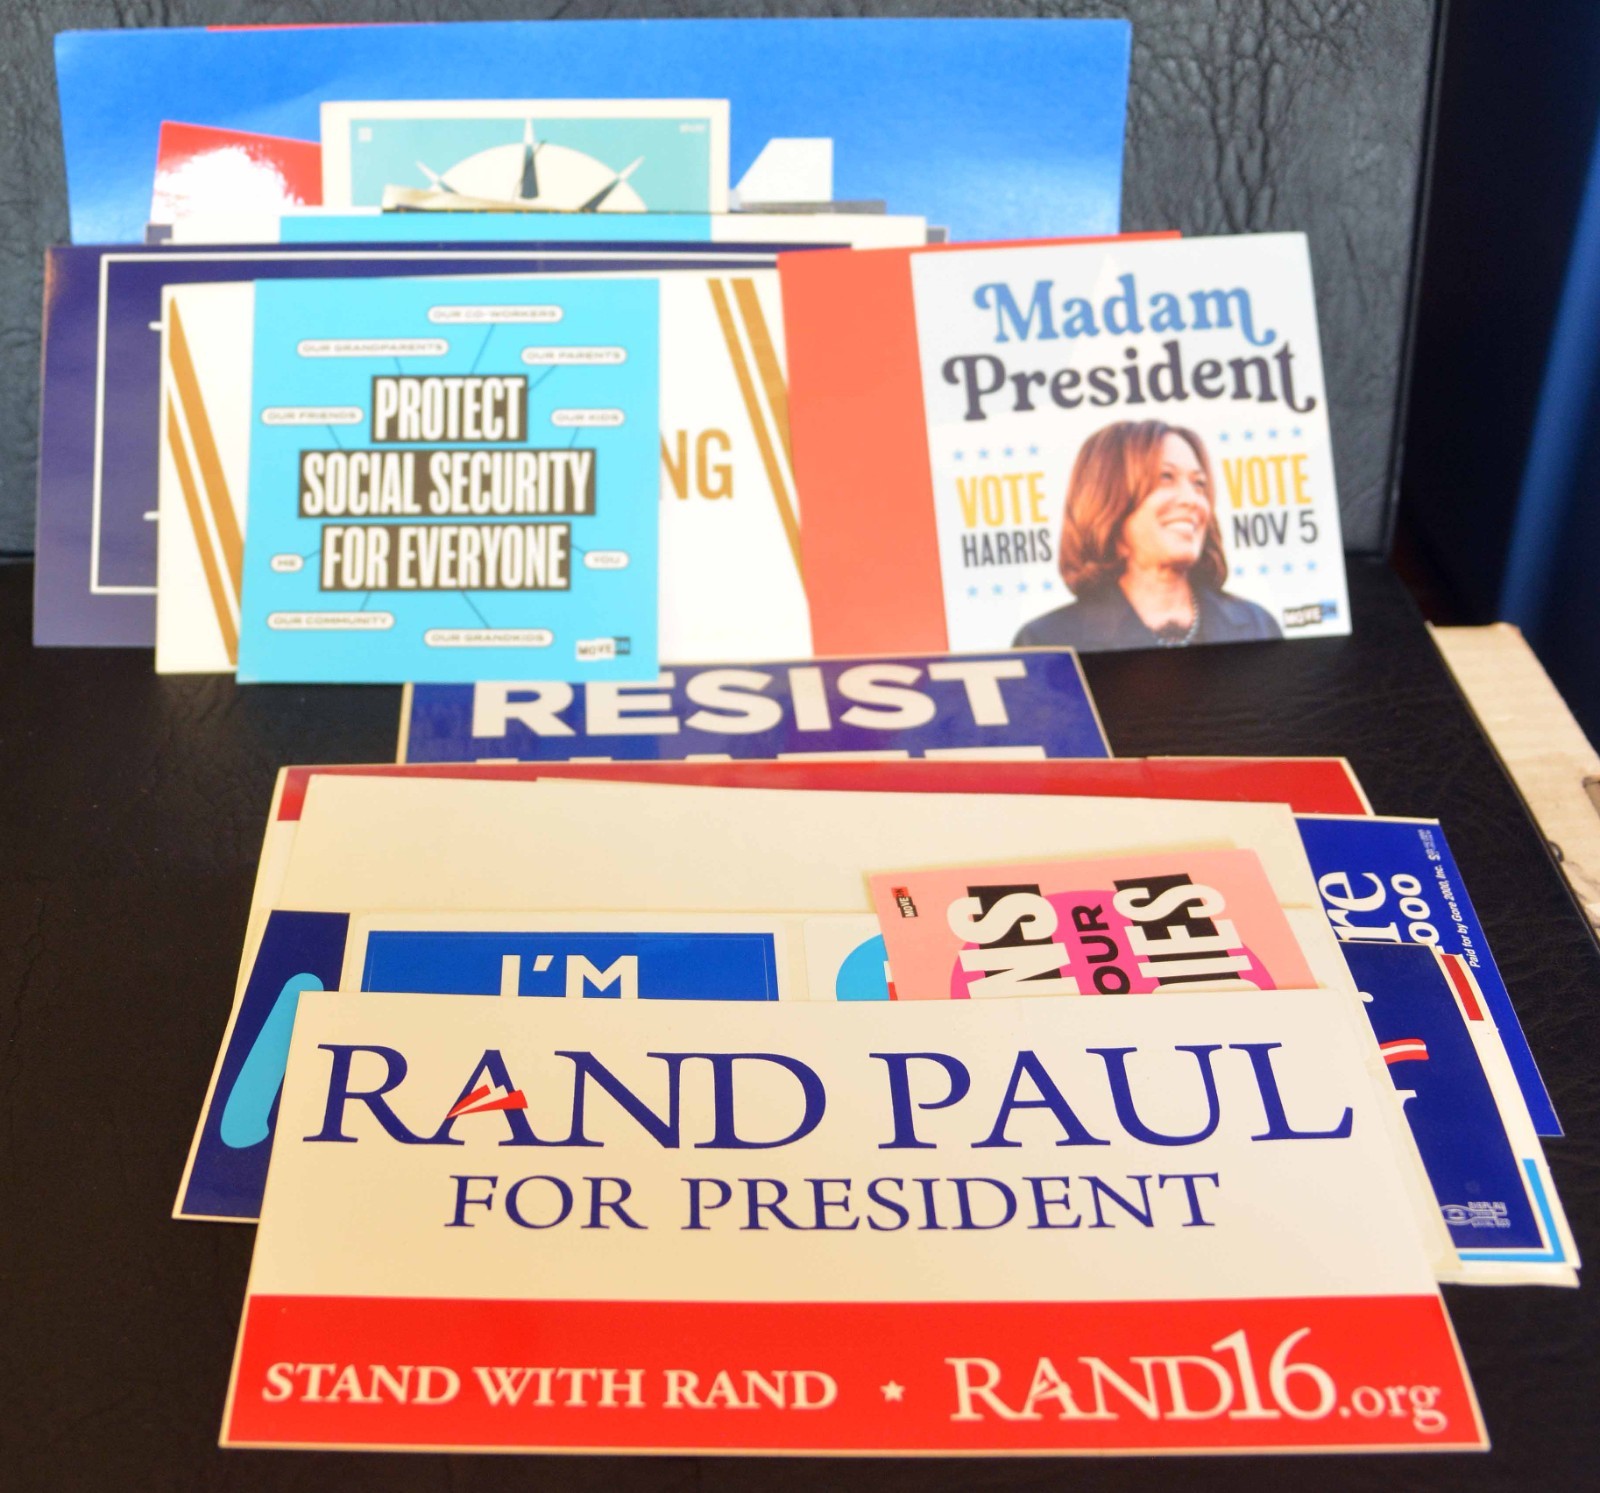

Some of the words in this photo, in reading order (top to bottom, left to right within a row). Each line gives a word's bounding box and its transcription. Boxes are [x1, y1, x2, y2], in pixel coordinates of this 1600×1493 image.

[434, 310, 461, 318] OUR
[465, 310, 556, 318] CO-WORKERS
[974, 273, 1276, 347] Madam
[303, 344, 331, 352] OUR
[334, 343, 443, 352] GRANDPARENTS
[528, 351, 555, 359] OUR
[558, 351, 621, 359] PARENTS
[942, 340, 1316, 421] President
[267, 411, 296, 420] OUR
[299, 410, 357, 420] FRIENDS
[375, 376, 525, 440] PROTECT
[556, 413, 585, 422] OUR
[588, 413, 619, 422] KIDS
[303, 453, 421, 516] SOCIAL
[429, 451, 592, 514] SECURITY
[956, 471, 1049, 527] VOTE
[1222, 453, 1312, 510] VOTE
[962, 529, 1052, 568] HARRIS
[1233, 511, 1288, 548] NOV
[1300, 510, 1318, 544] 5
[322, 527, 390, 588] FOR
[398, 525, 568, 588] EVERYONE
[593, 555, 620, 564] YOU
[274, 616, 302, 625] OUR
[305, 616, 387, 625] COMMUNITY
[431, 633, 460, 642] OUR
[464, 633, 544, 642] GRANDKIDS
[472, 659, 1026, 738] RESIST
[1391, 873, 1445, 953] 000
[1448, 901, 1463, 921] Gore
[1456, 923, 1469, 935] by
[1071, 904, 1131, 995] OUR
[1112, 883, 1262, 994] IES
[1461, 935, 1473, 949] for
[1464, 948, 1480, 968] Paid
[303, 1044, 826, 1149] RAND
[869, 1042, 1353, 1149] PAUL
[444, 1175, 648, 1230] FOR
[680, 1172, 1220, 1232] PRESIDENT
[262, 1361, 460, 1406] STAND
[473, 1366, 646, 1408] WITH
[663, 1369, 838, 1410] RAND
[945, 1327, 1448, 1434] RAND16.org
